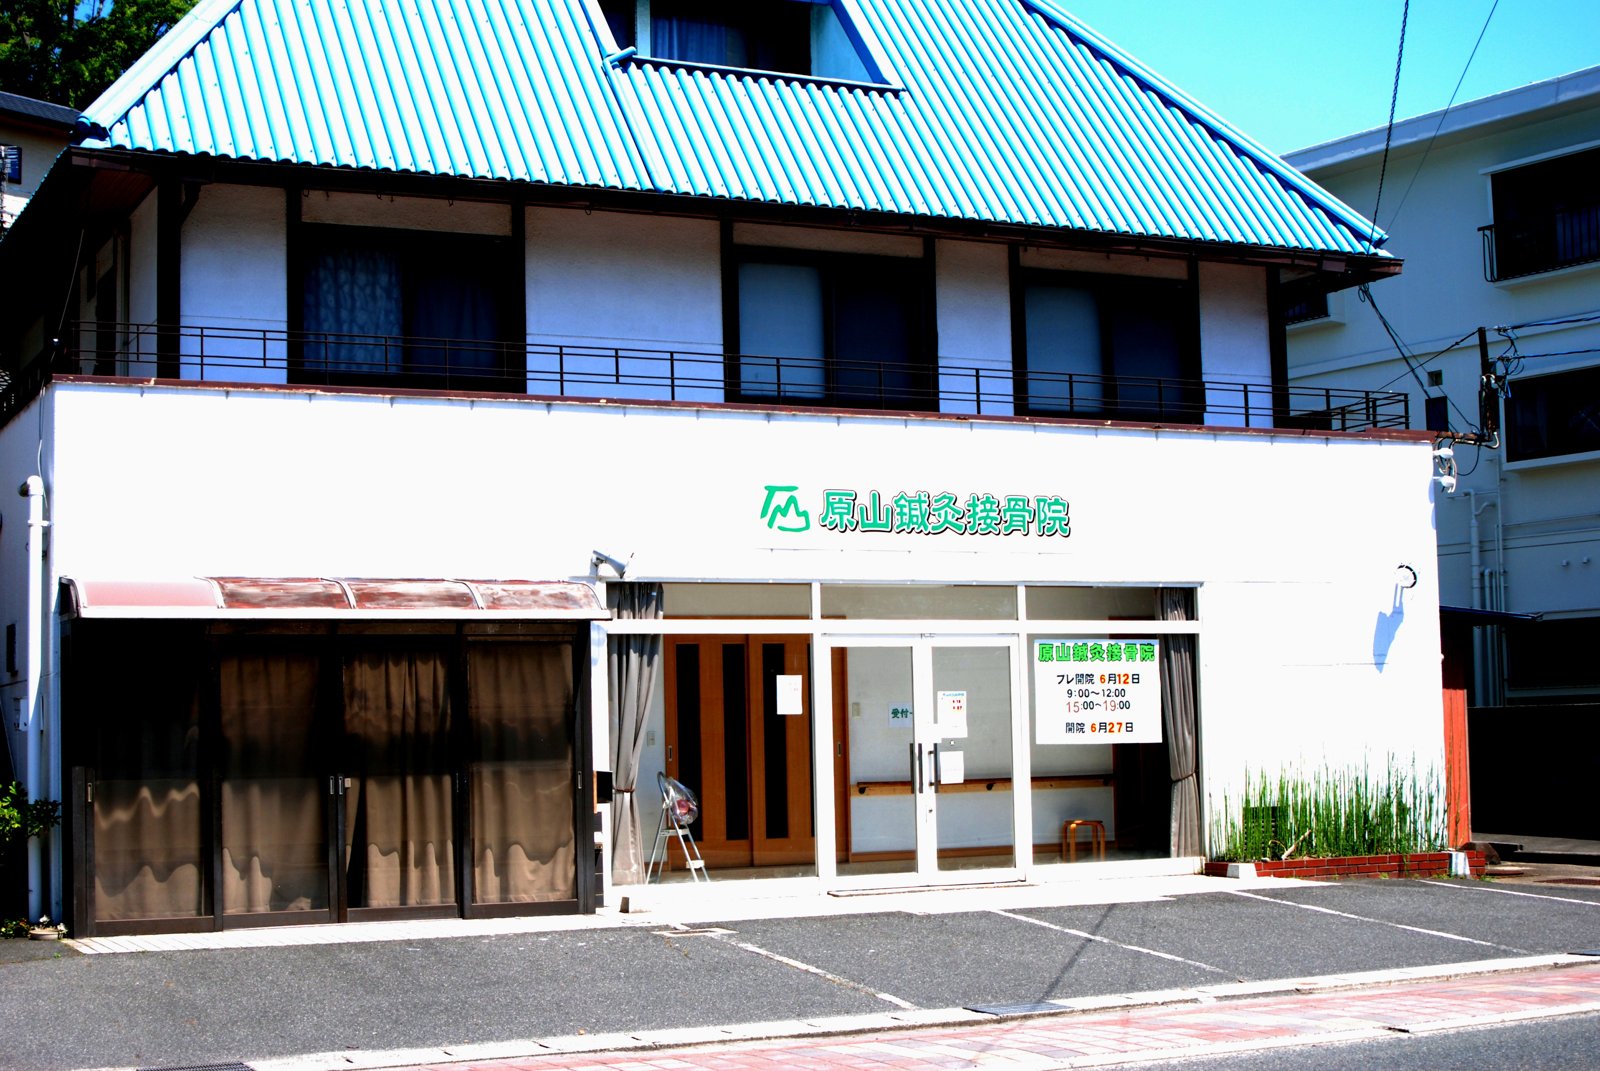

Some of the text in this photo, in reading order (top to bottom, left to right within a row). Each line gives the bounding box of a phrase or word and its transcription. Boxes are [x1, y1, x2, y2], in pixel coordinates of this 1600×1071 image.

[819, 489, 1071, 537] 原山鍼灸接骨院
[1038, 643, 1156, 662] 原山鍼灸接骨院
